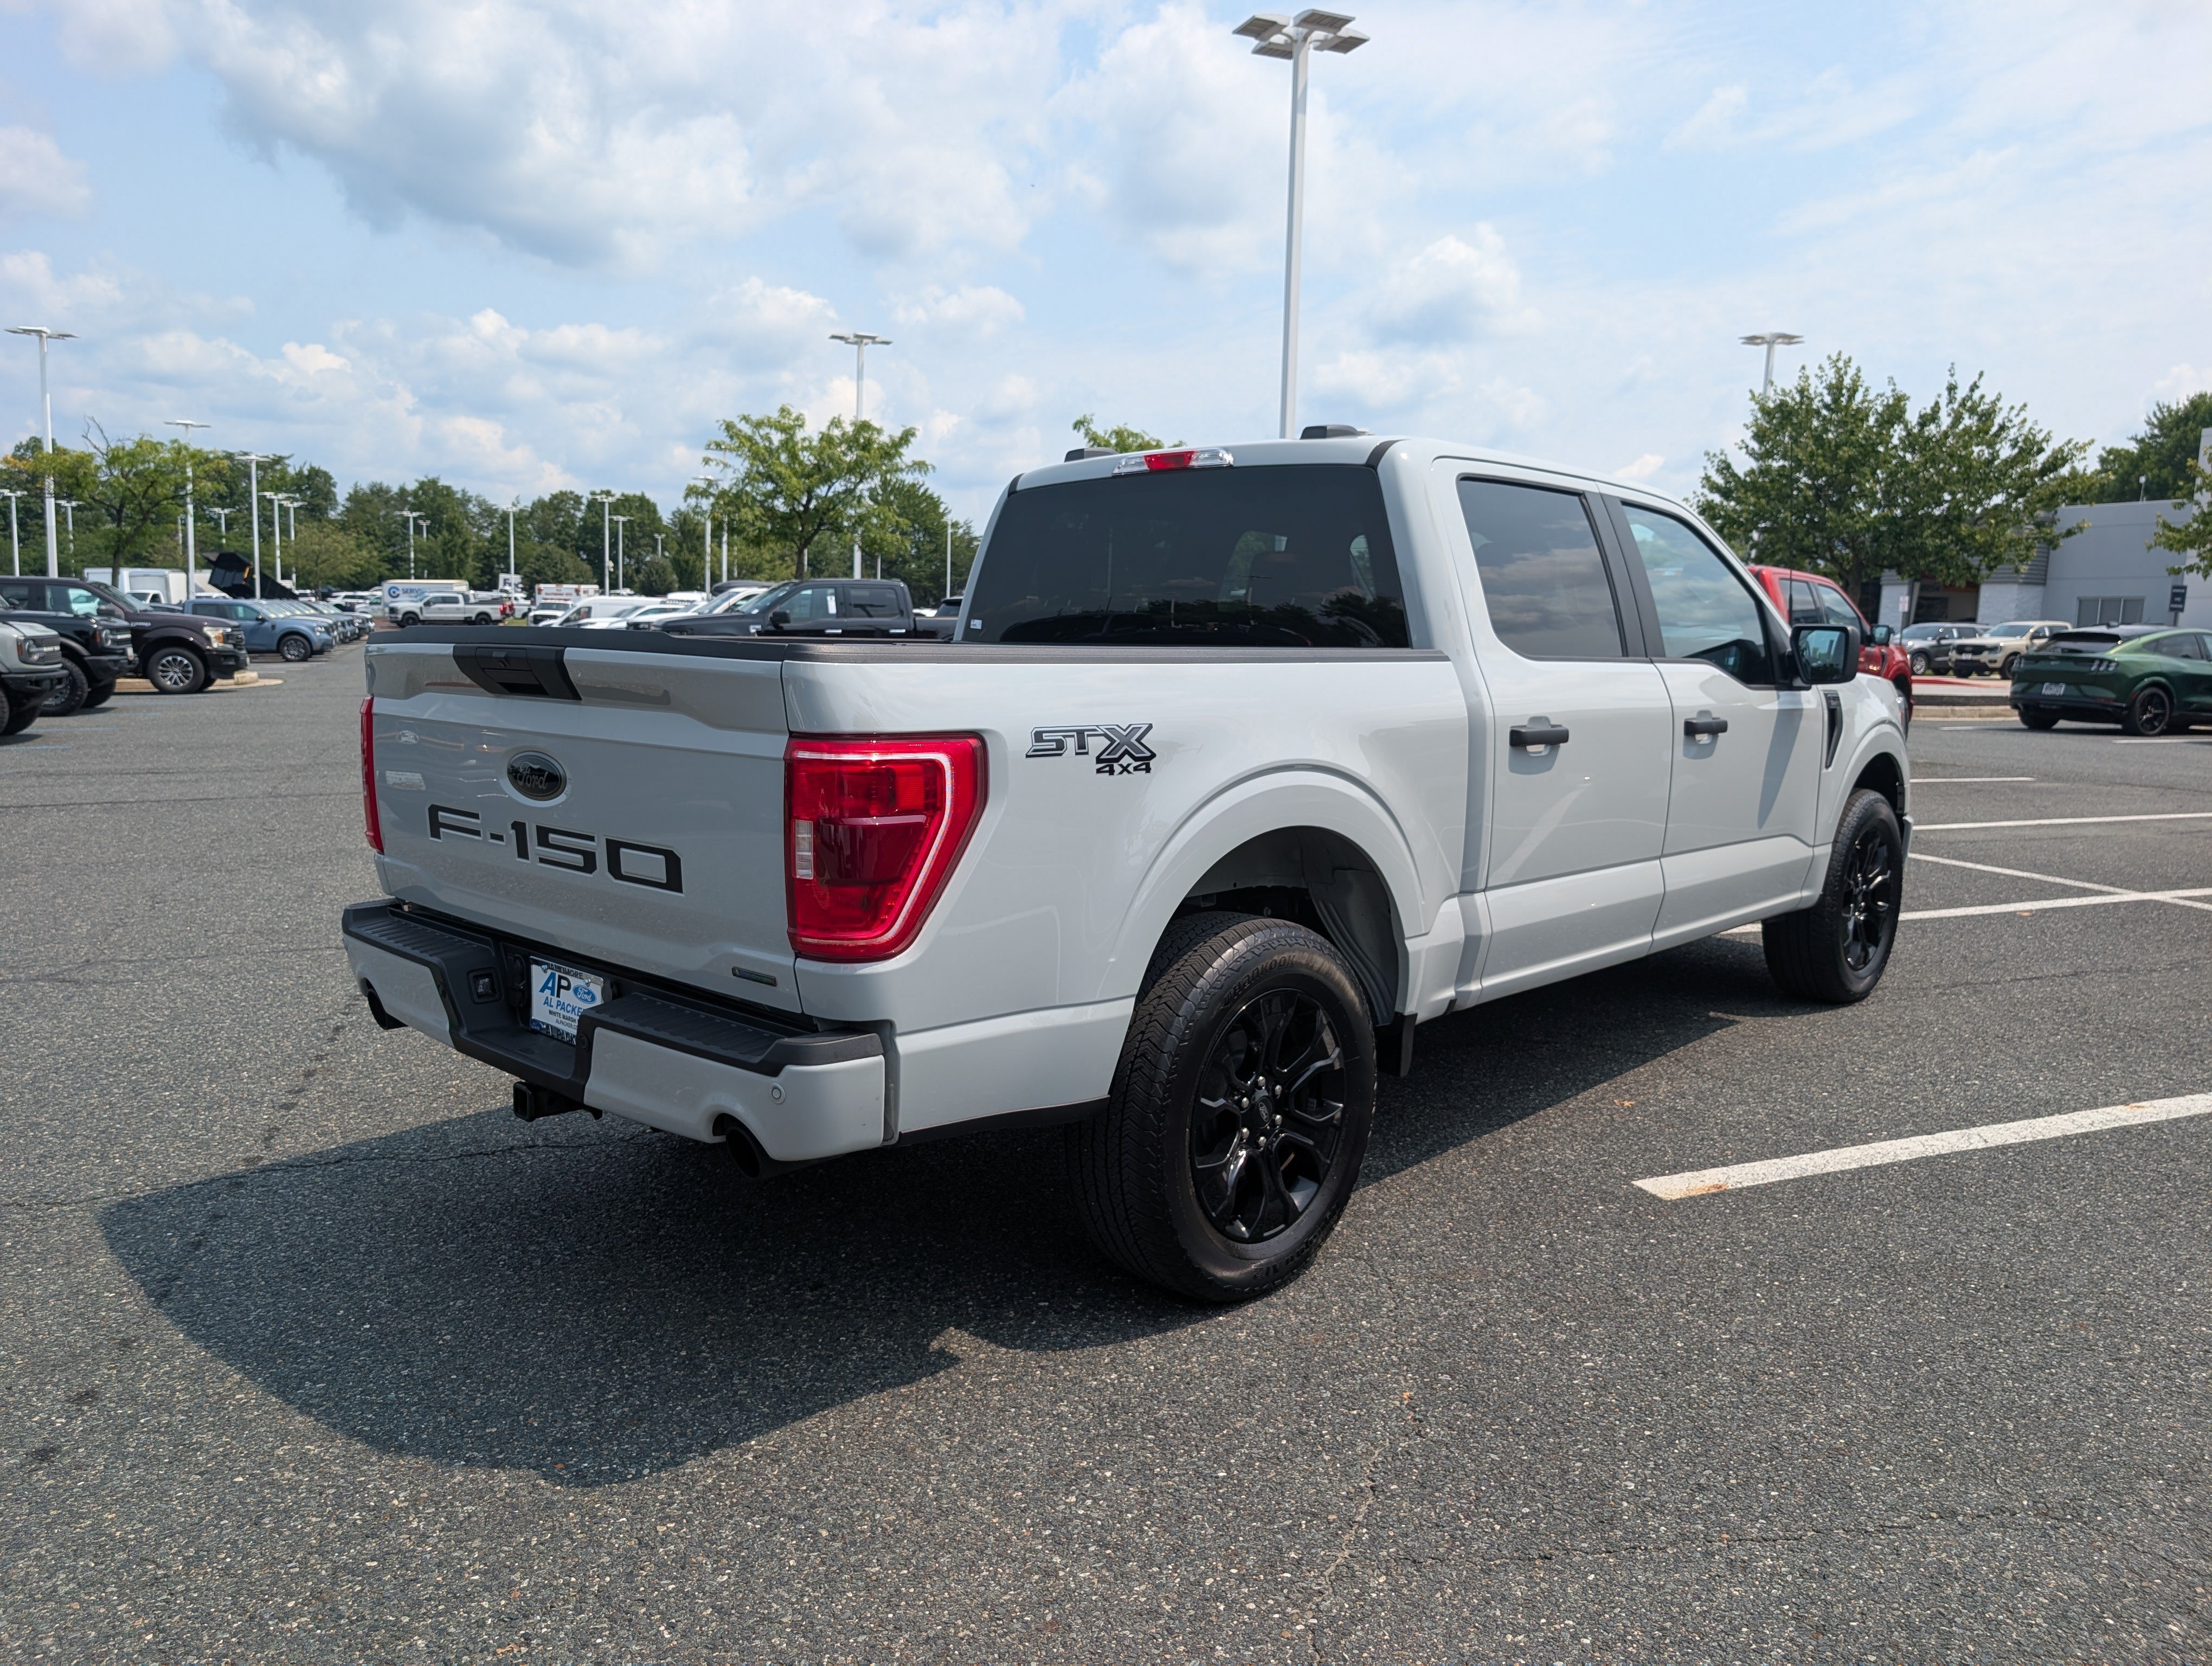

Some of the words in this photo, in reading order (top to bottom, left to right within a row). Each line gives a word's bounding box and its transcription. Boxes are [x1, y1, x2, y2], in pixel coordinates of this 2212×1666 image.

[1025, 723, 1156, 764] STX
[517, 761, 548, 790] Ford
[428, 803, 684, 894] F-150
[539, 971, 571, 998] AP
[543, 996, 554, 1008] AL
[556, 1000, 584, 1017] PACKE
[548, 1009, 562, 1018] WHITE
[562, 1013, 577, 1023] MARSH
[556, 1018, 578, 1030] ALPACKER.CO
[557, 1028, 577, 1045] PACK
